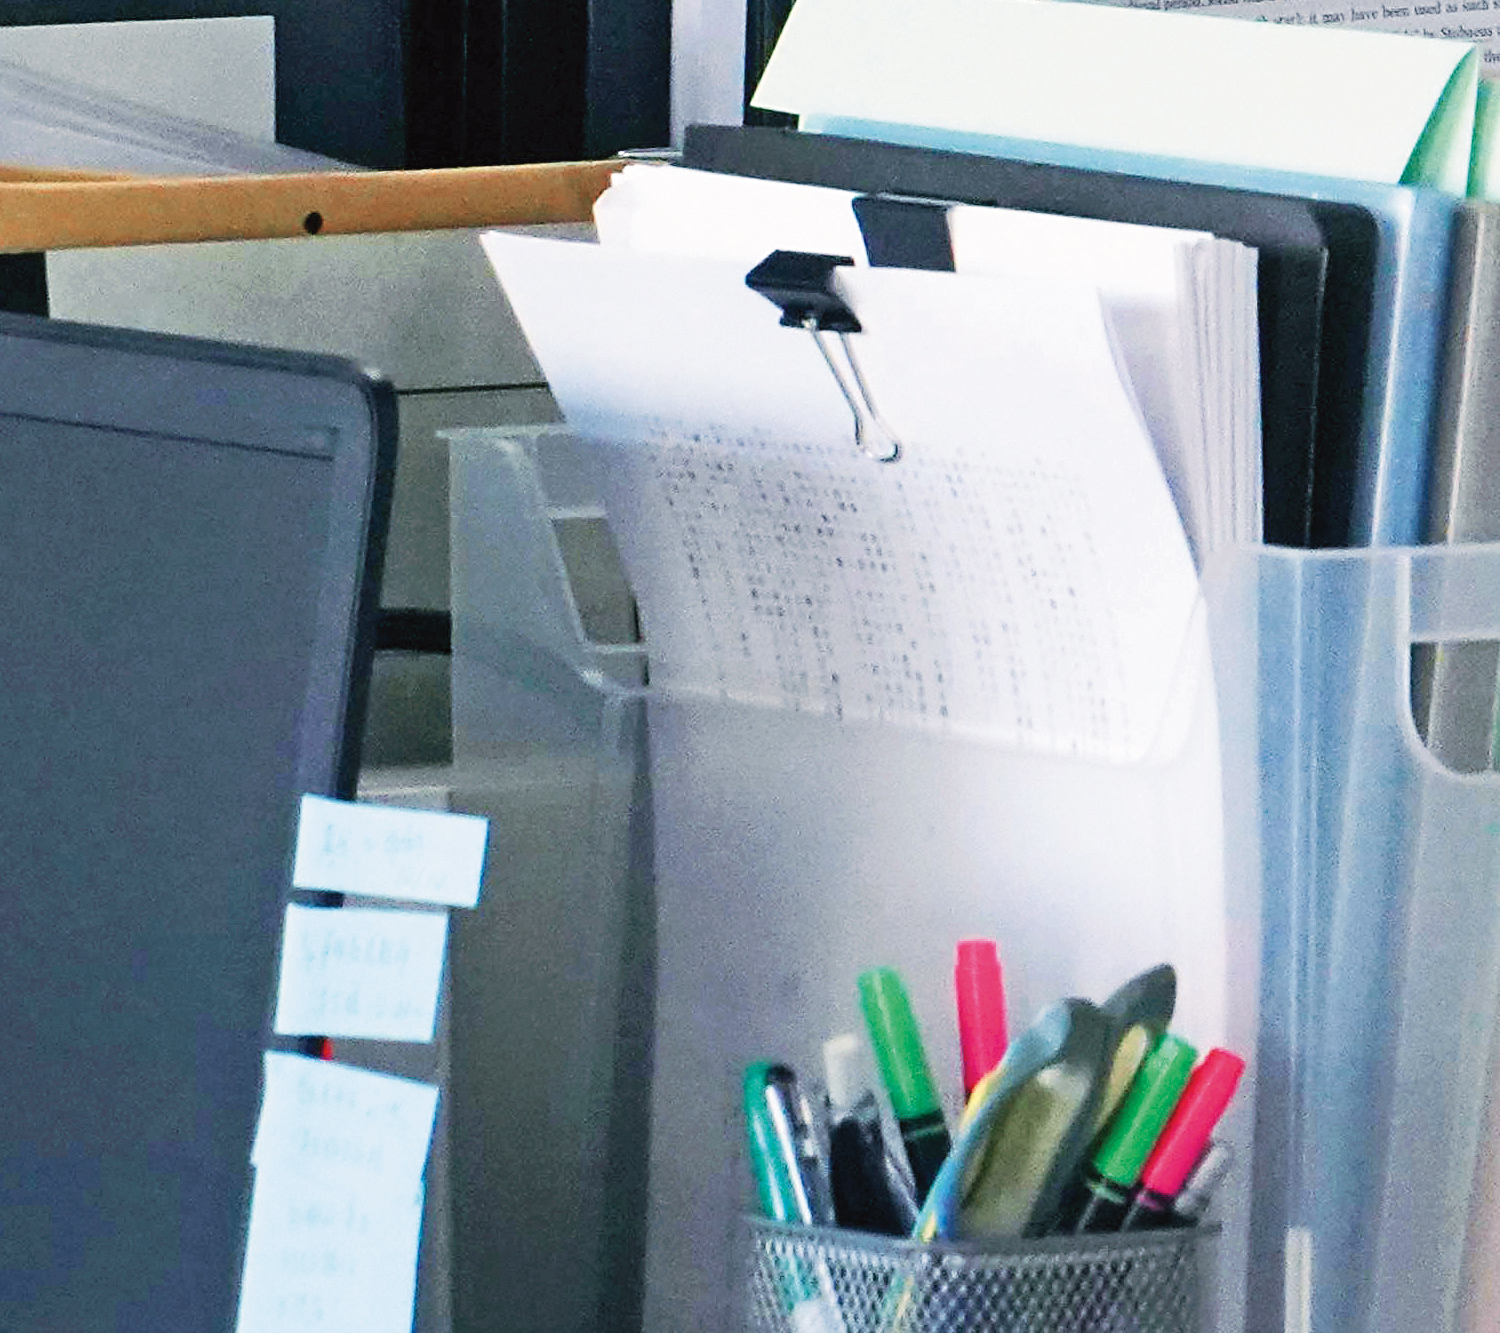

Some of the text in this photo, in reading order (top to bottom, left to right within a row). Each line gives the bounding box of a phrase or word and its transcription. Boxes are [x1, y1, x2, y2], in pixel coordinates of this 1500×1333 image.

[1351, 7, 1379, 21] have
[1382, 4, 1410, 19] been
[1414, 1, 1441, 16] used
